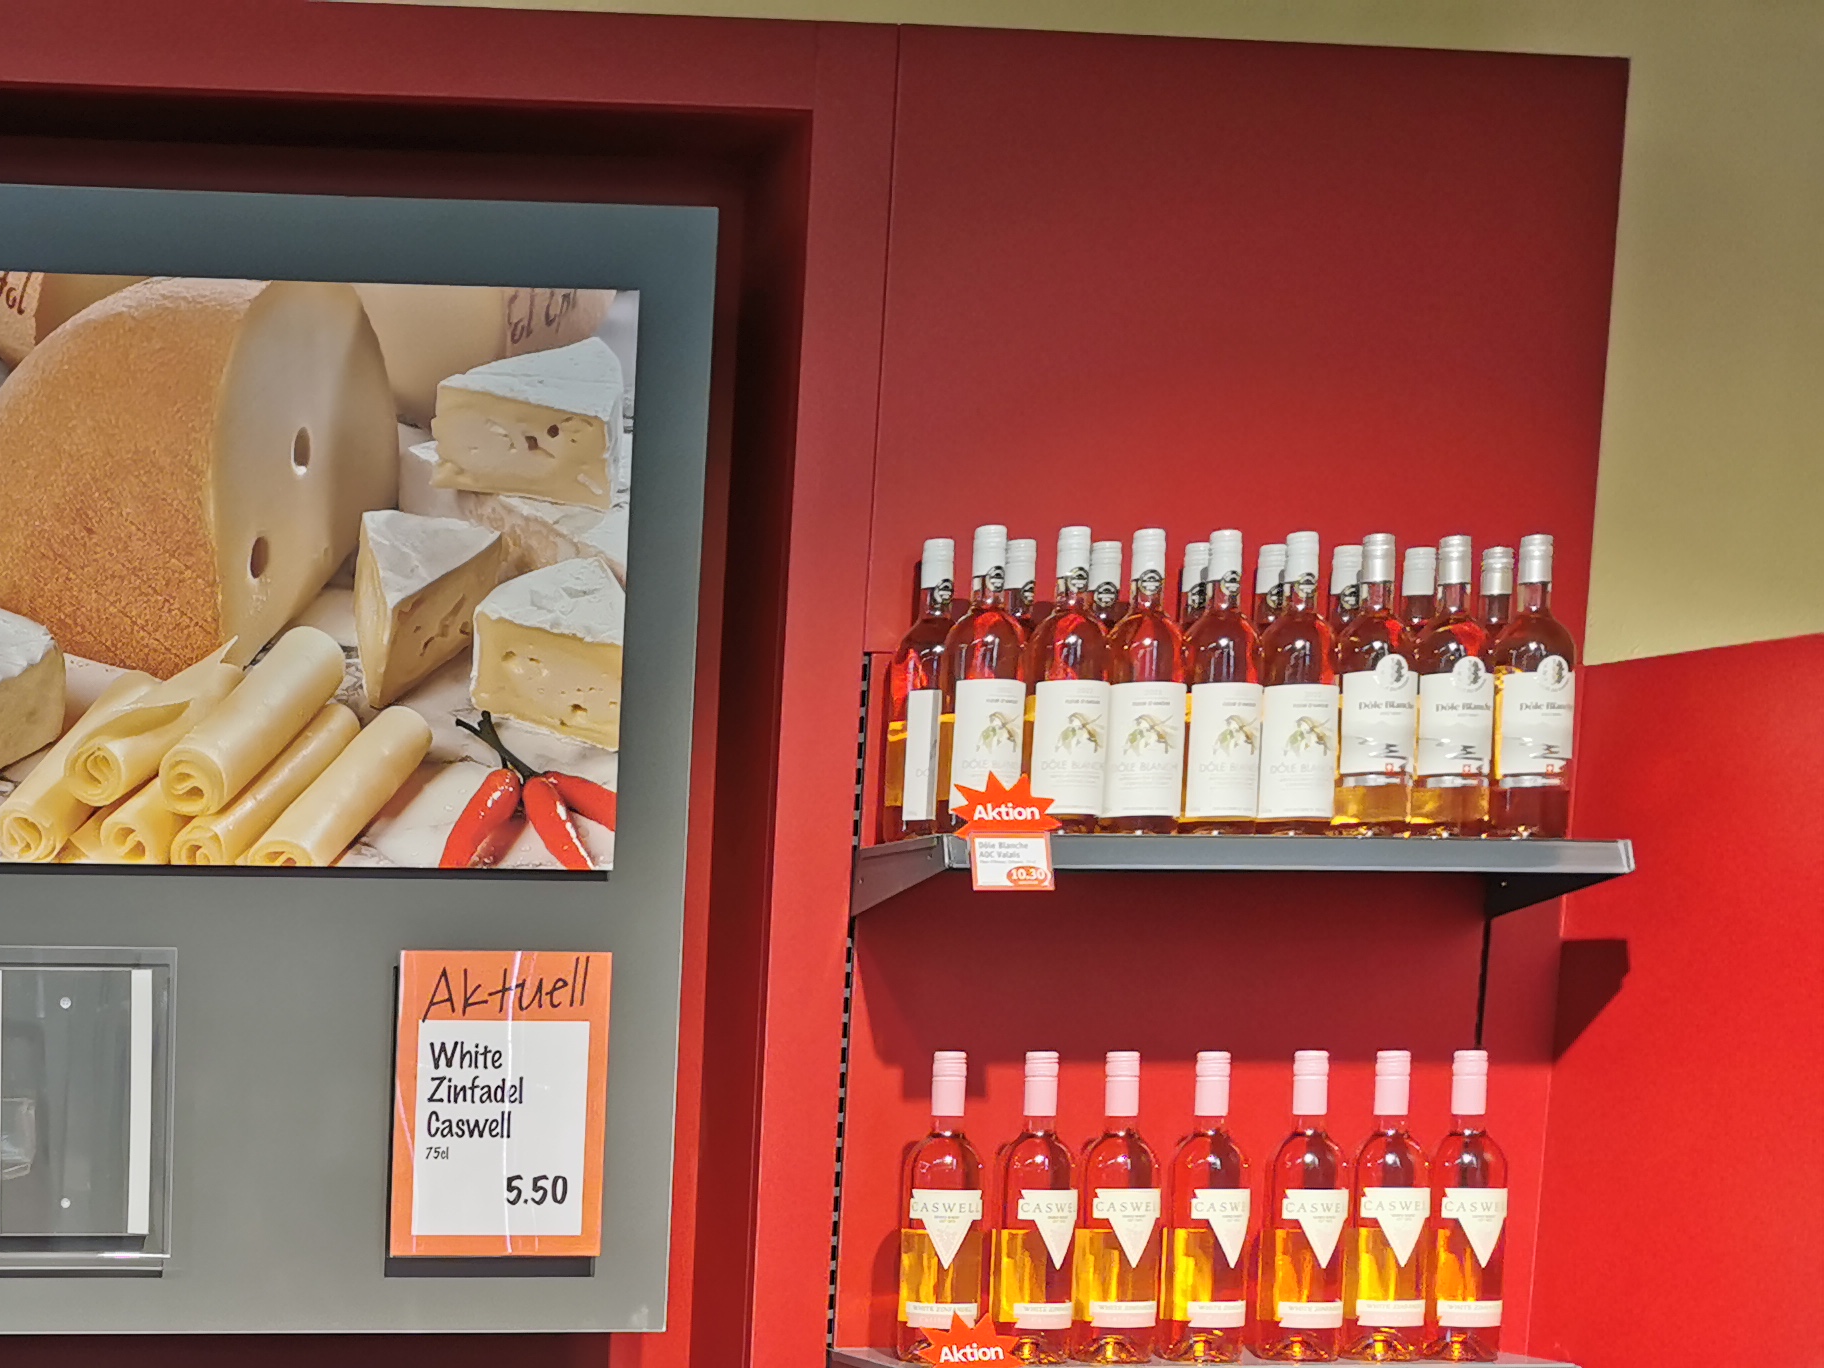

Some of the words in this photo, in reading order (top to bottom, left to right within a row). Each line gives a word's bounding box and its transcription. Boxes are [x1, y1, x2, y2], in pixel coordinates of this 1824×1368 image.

[1359, 701, 1384, 711] Dôle
[1436, 703, 1461, 713] Dôle
[1520, 702, 1544, 711] Dôle
[972, 802, 1041, 821] Aktion
[998, 841, 1028, 849] Blanche
[1011, 868, 1046, 880] 10.30
[422, 956, 590, 1022] Aktuell
[430, 1041, 503, 1069] White
[427, 1076, 524, 1104] Zinfadel
[426, 1110, 512, 1139] Caswell
[425, 1146, 449, 1160] 75cl
[506, 1175, 568, 1205] 5.50
[910, 1200, 980, 1214] CASWELL
[939, 1342, 1005, 1364] Aktion
